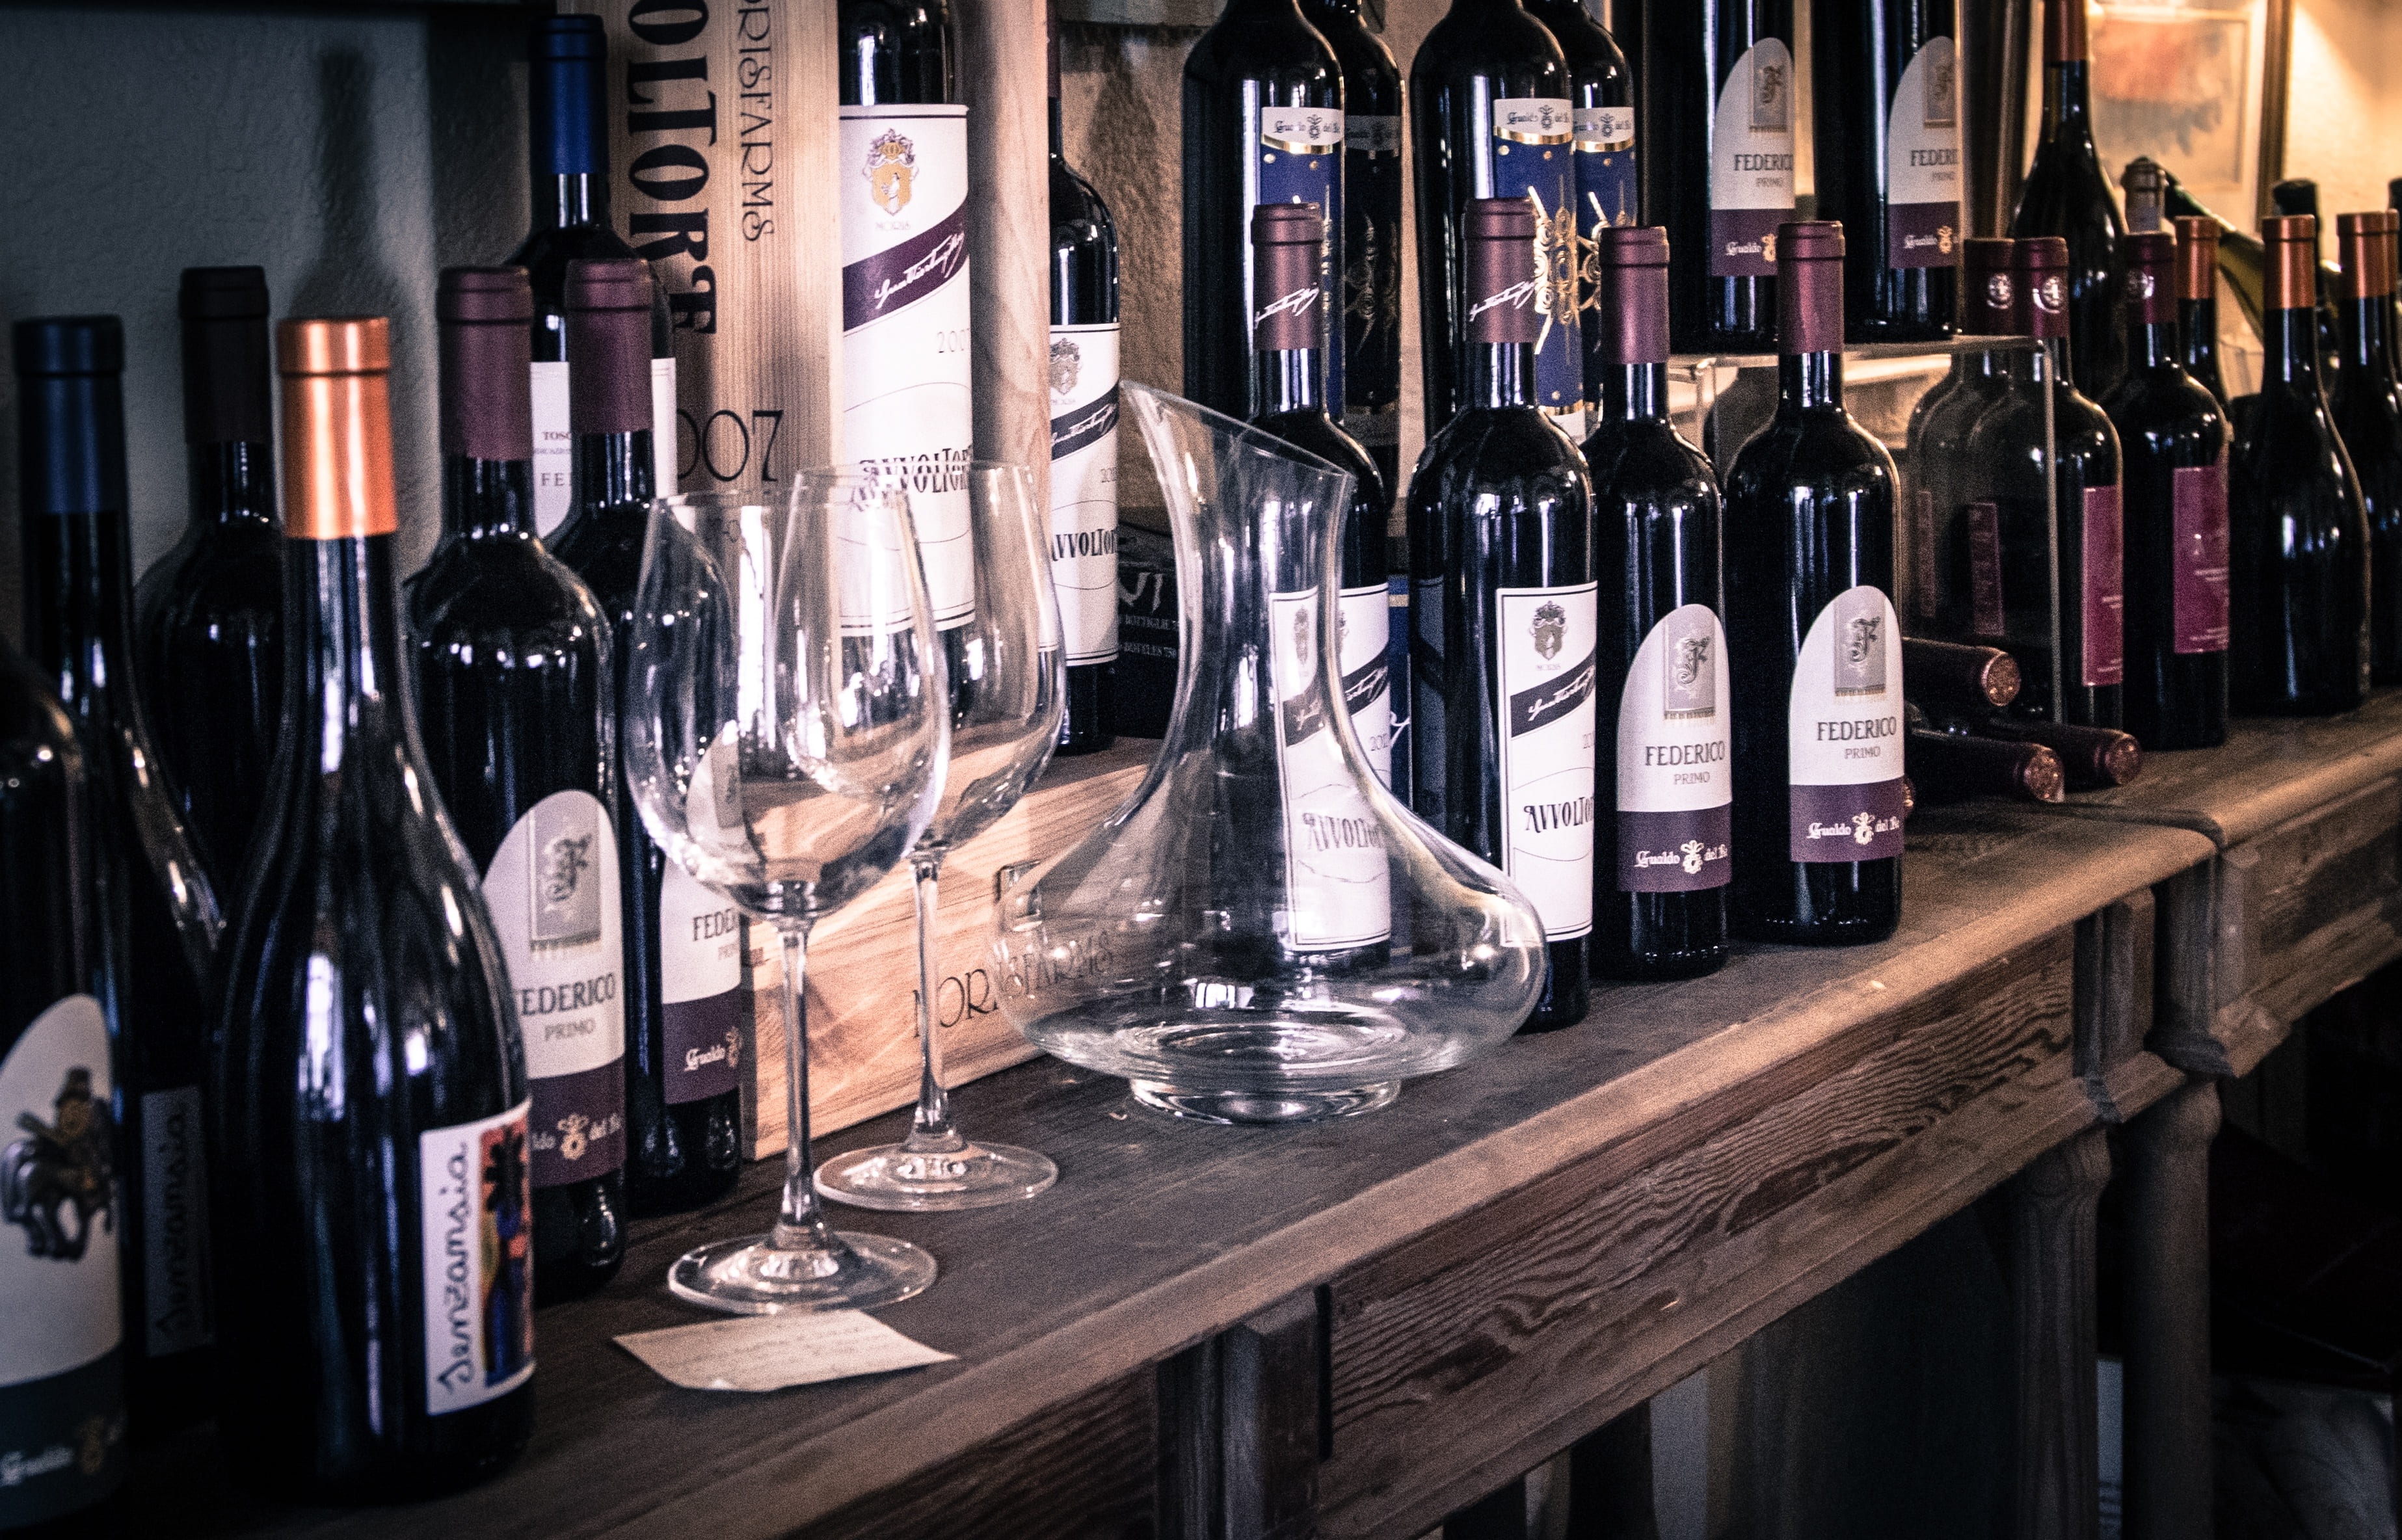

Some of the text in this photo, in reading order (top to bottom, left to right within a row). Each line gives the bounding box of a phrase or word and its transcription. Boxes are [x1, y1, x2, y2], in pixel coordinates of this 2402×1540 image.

[738, 0, 775, 241] RISFARMS
[1816, 716, 1897, 741] FEDERICO
[1645, 740, 1726, 766] FEDERICO
[1845, 746, 1881, 760] PRIMO
[1674, 771, 1711, 785] PRIMO
[516, 972, 615, 1016] EDERICO
